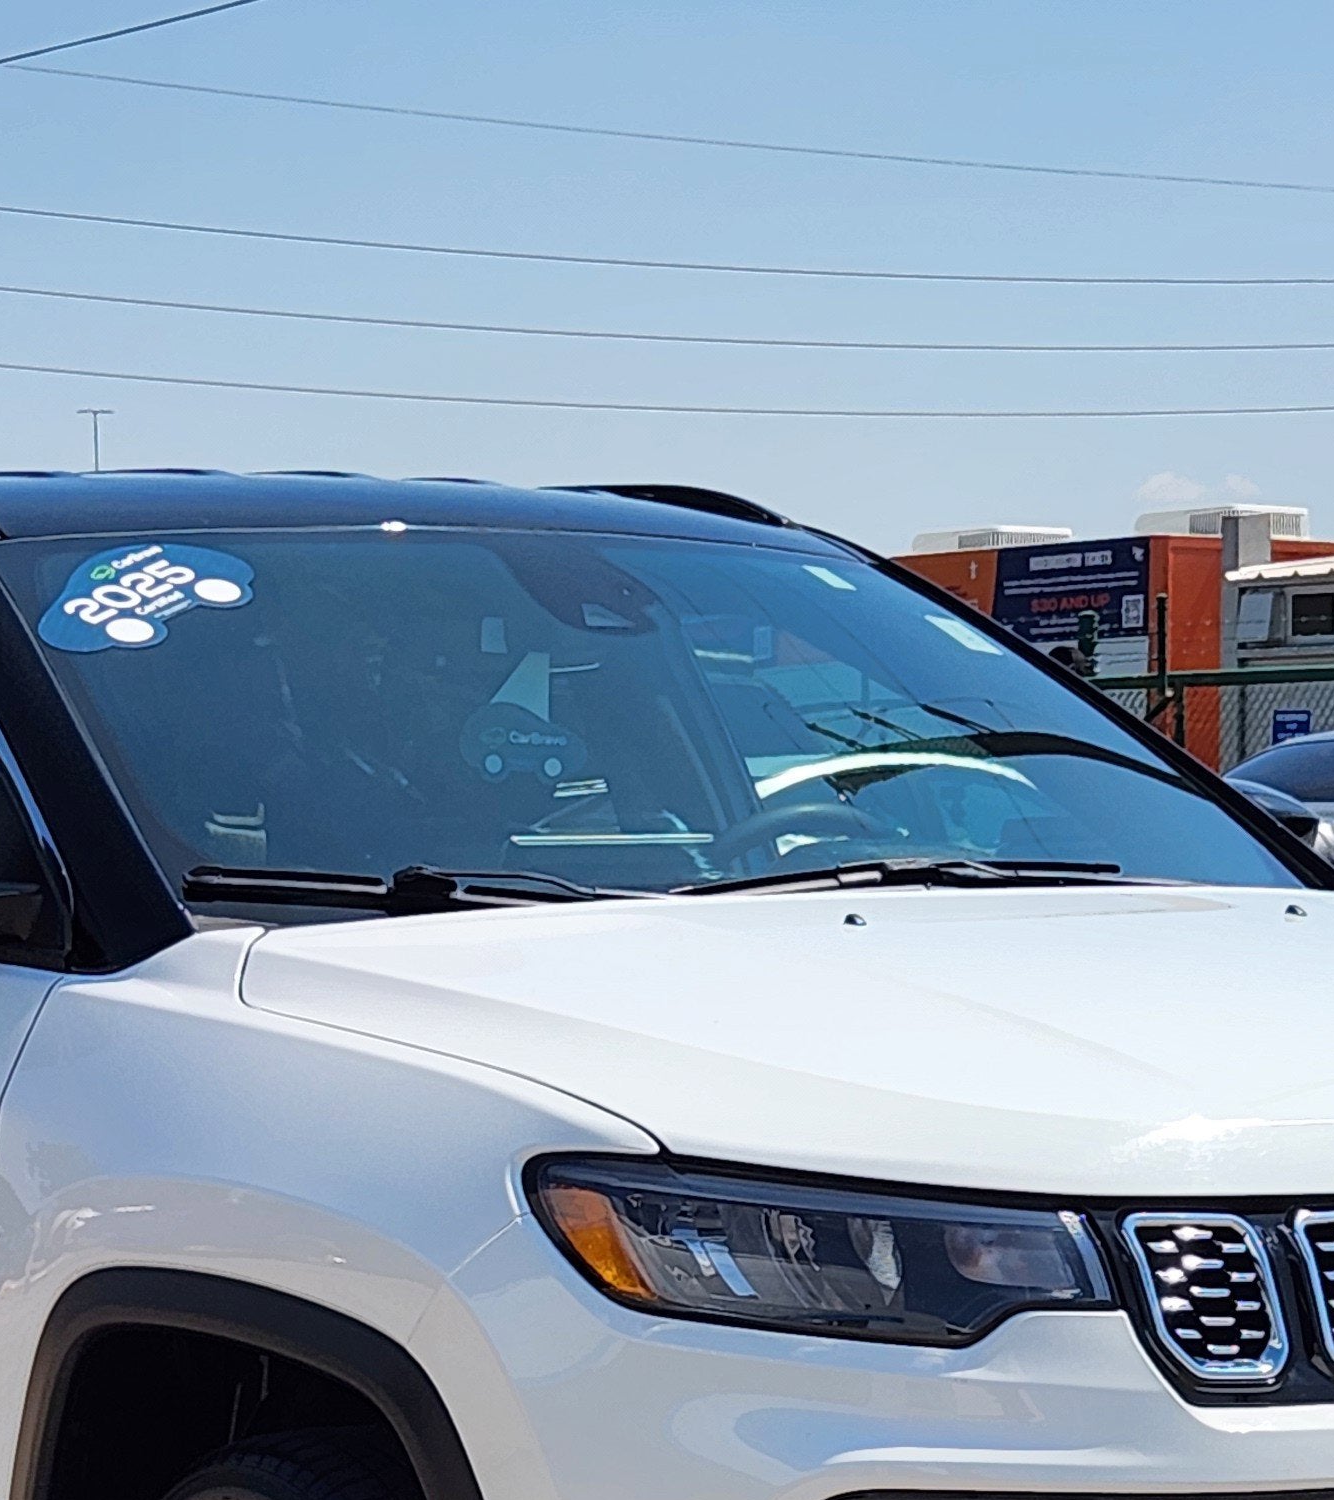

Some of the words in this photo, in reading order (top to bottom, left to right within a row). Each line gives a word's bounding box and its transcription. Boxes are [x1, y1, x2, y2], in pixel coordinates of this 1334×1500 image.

[63, 559, 195, 625] 2025
[1030, 598, 1058, 613] $30
[1060, 594, 1088, 610] AND
[1090, 592, 1110, 607] UP
